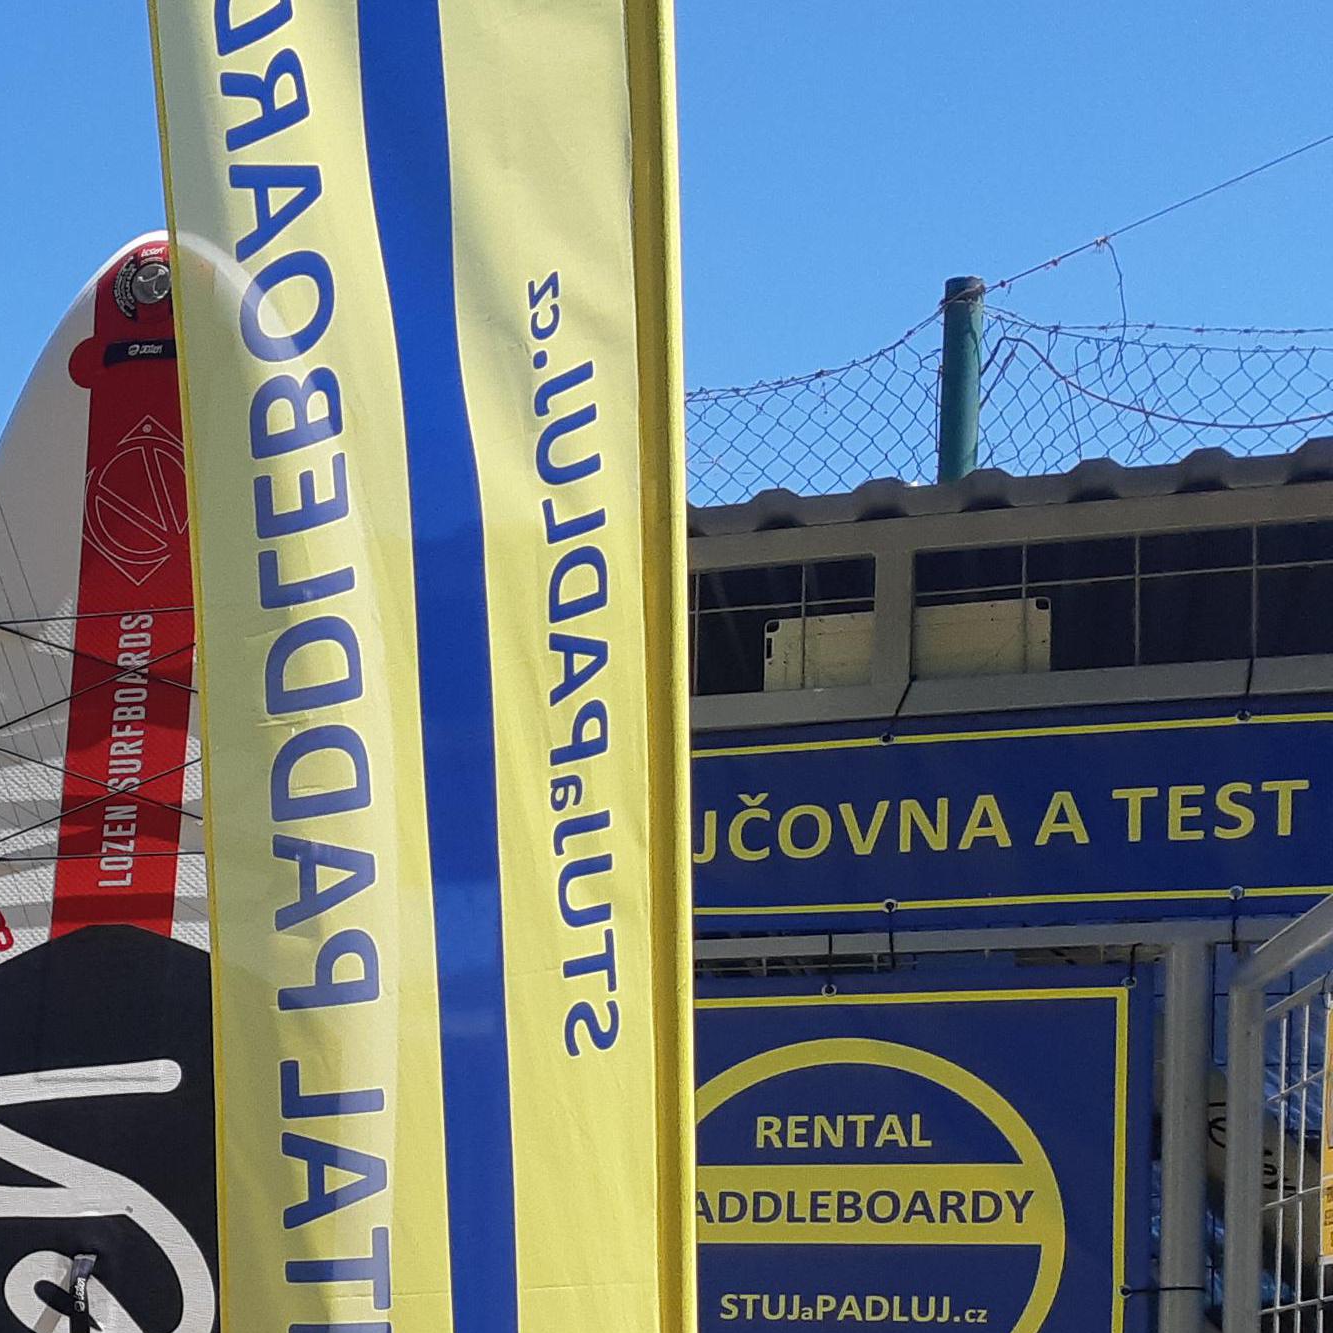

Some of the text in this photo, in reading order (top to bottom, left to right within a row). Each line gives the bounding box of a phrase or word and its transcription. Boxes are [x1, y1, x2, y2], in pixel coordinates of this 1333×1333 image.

[99, 613, 154, 888] LOZEN SURFBOARDS
[1034, 790, 1090, 846] A
[1112, 779, 1310, 843] TEST
[755, 1112, 933, 1149] RENTAL
[720, 1292, 988, 1325] STUJaPADLUJ.cz
